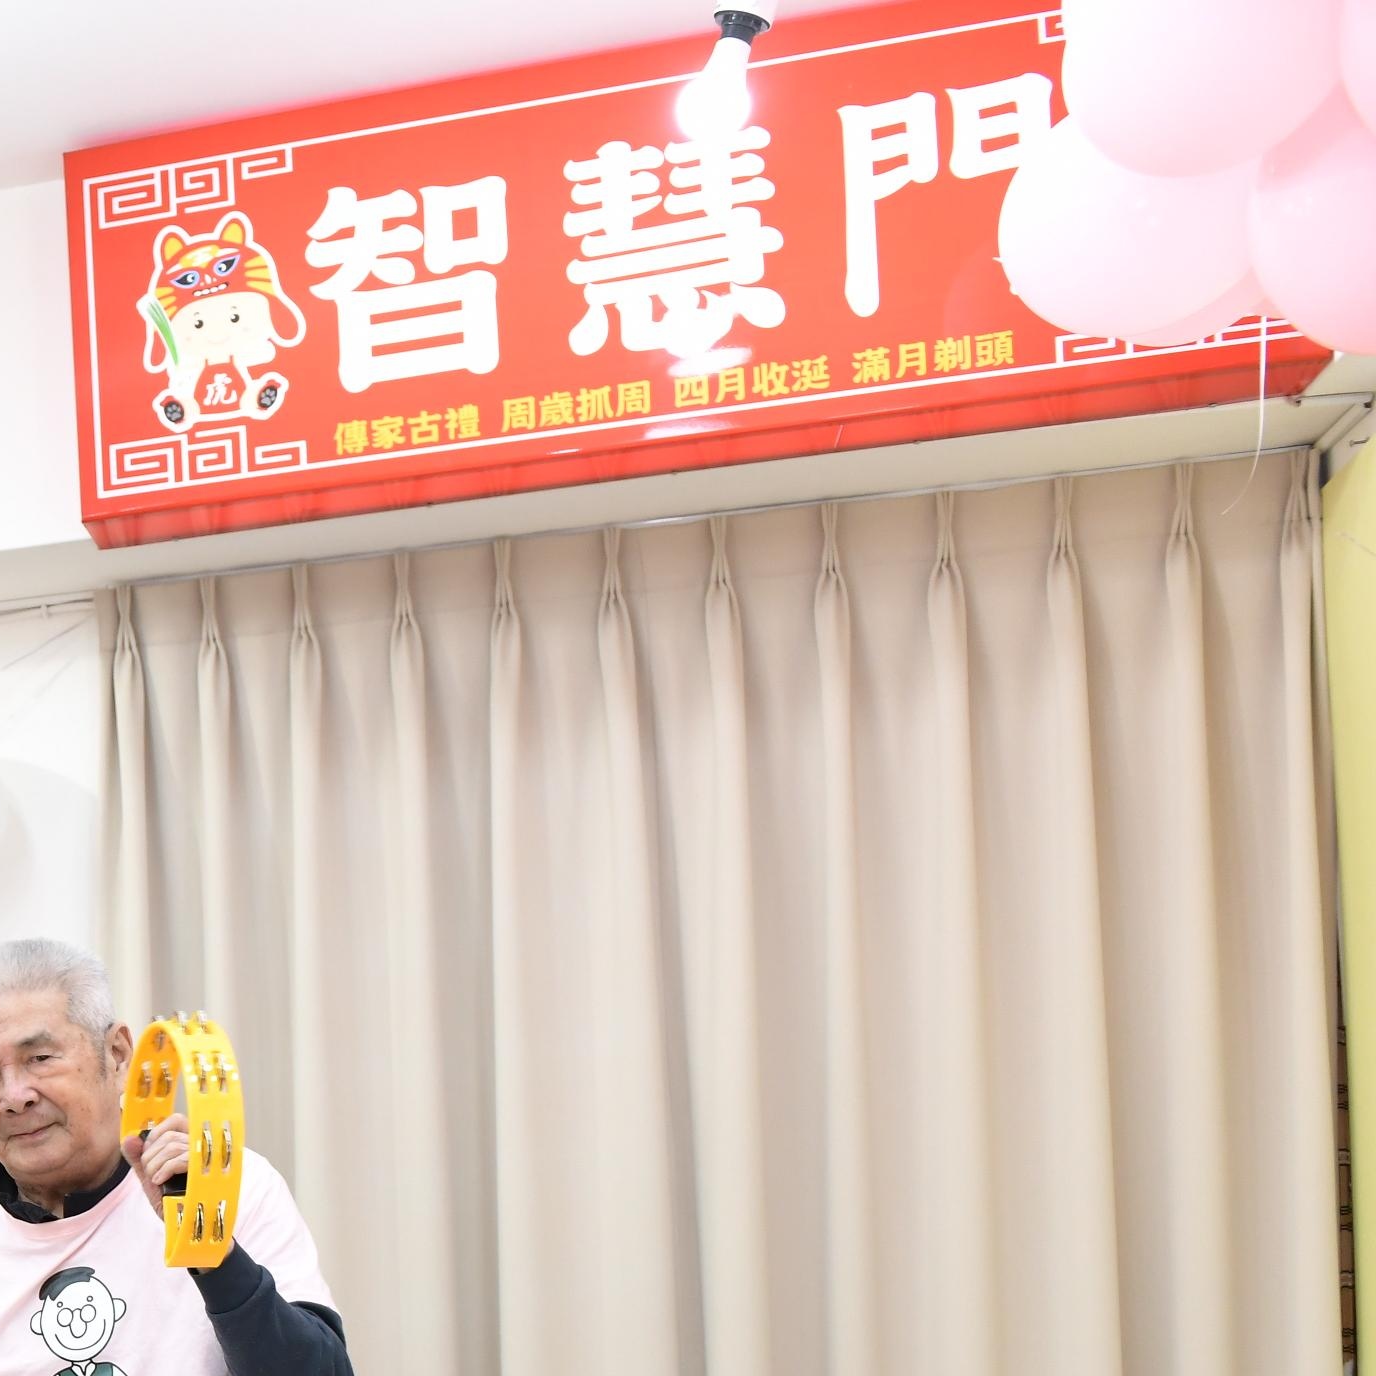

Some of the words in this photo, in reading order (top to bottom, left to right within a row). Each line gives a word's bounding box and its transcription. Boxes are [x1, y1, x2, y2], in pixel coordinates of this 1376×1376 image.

[332, 404, 482, 456] 傳家古禮
[500, 378, 652, 434] 周歲抓周
[673, 353, 832, 408] 四月收涎
[851, 330, 1017, 384] 滿月剃頭
